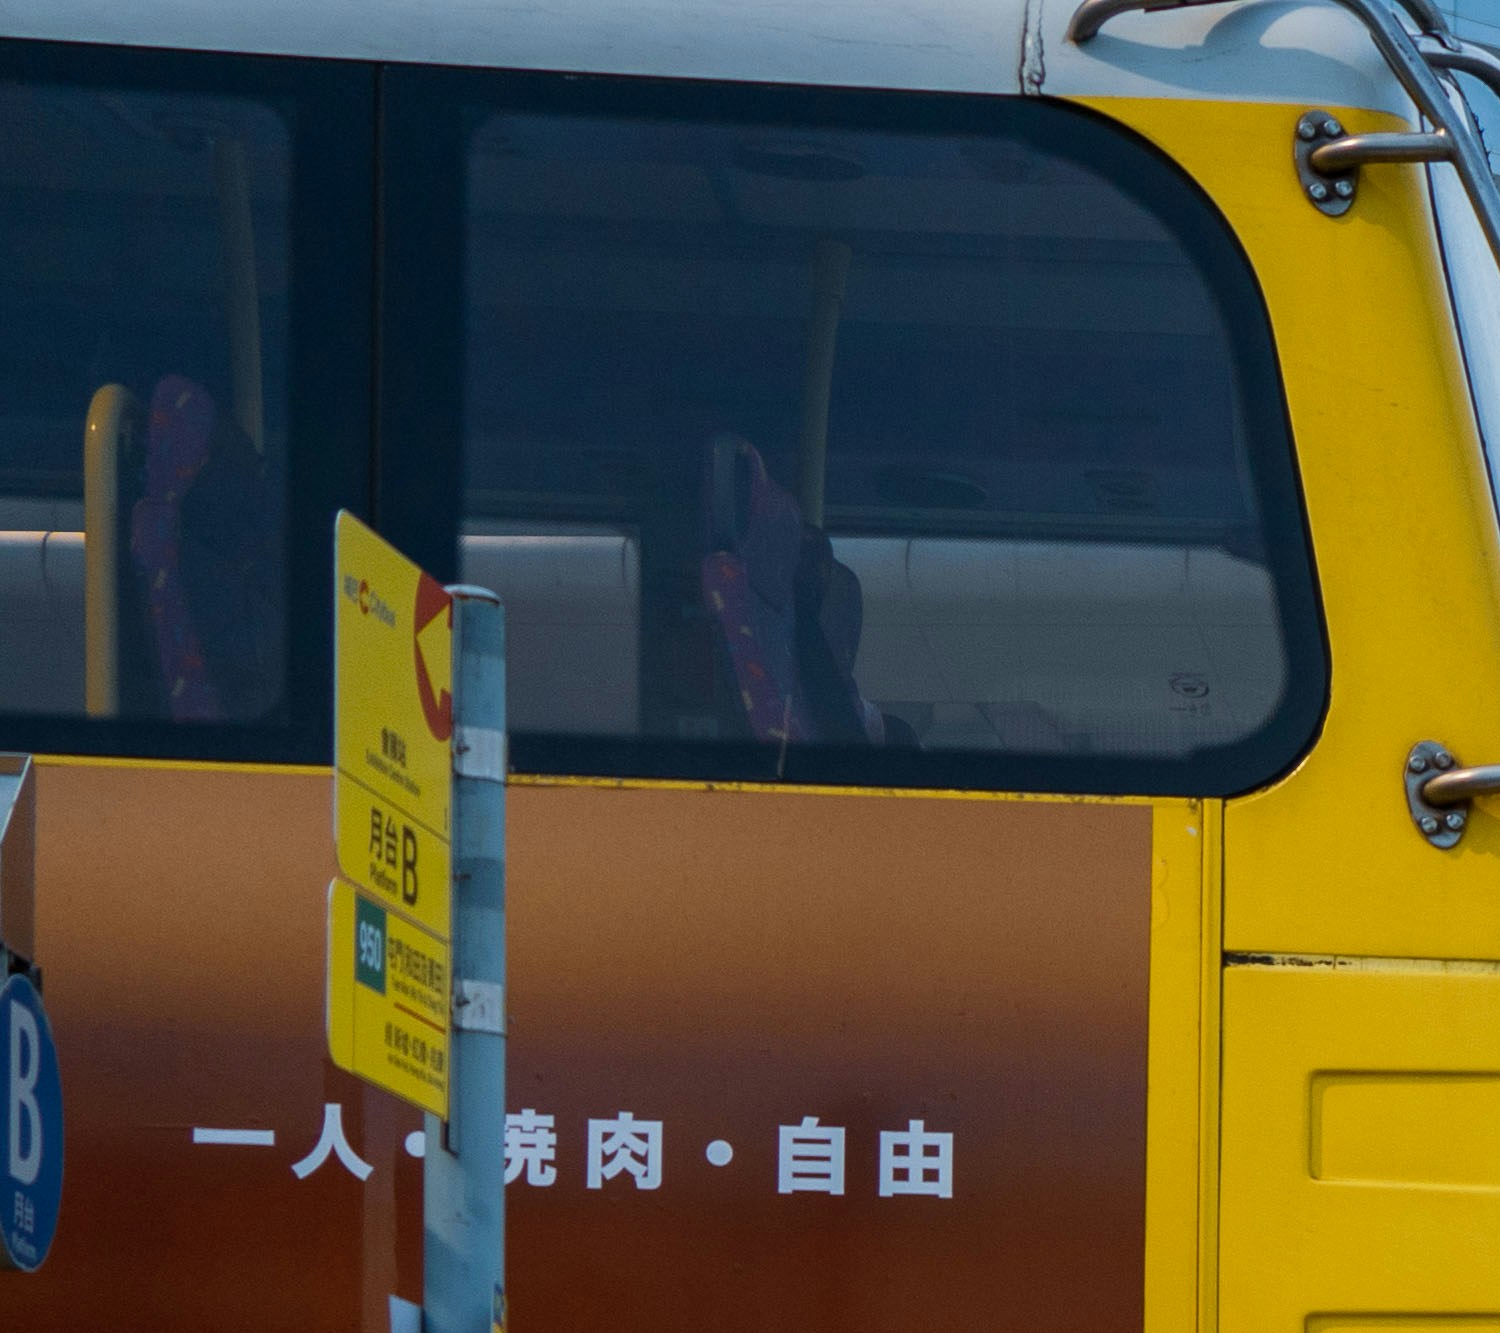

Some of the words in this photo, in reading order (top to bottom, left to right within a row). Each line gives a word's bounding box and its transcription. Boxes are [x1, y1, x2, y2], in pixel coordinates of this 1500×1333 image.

[402, 824, 418, 906] B
[359, 920, 381, 972] 950
[9, 1000, 41, 1186] B
